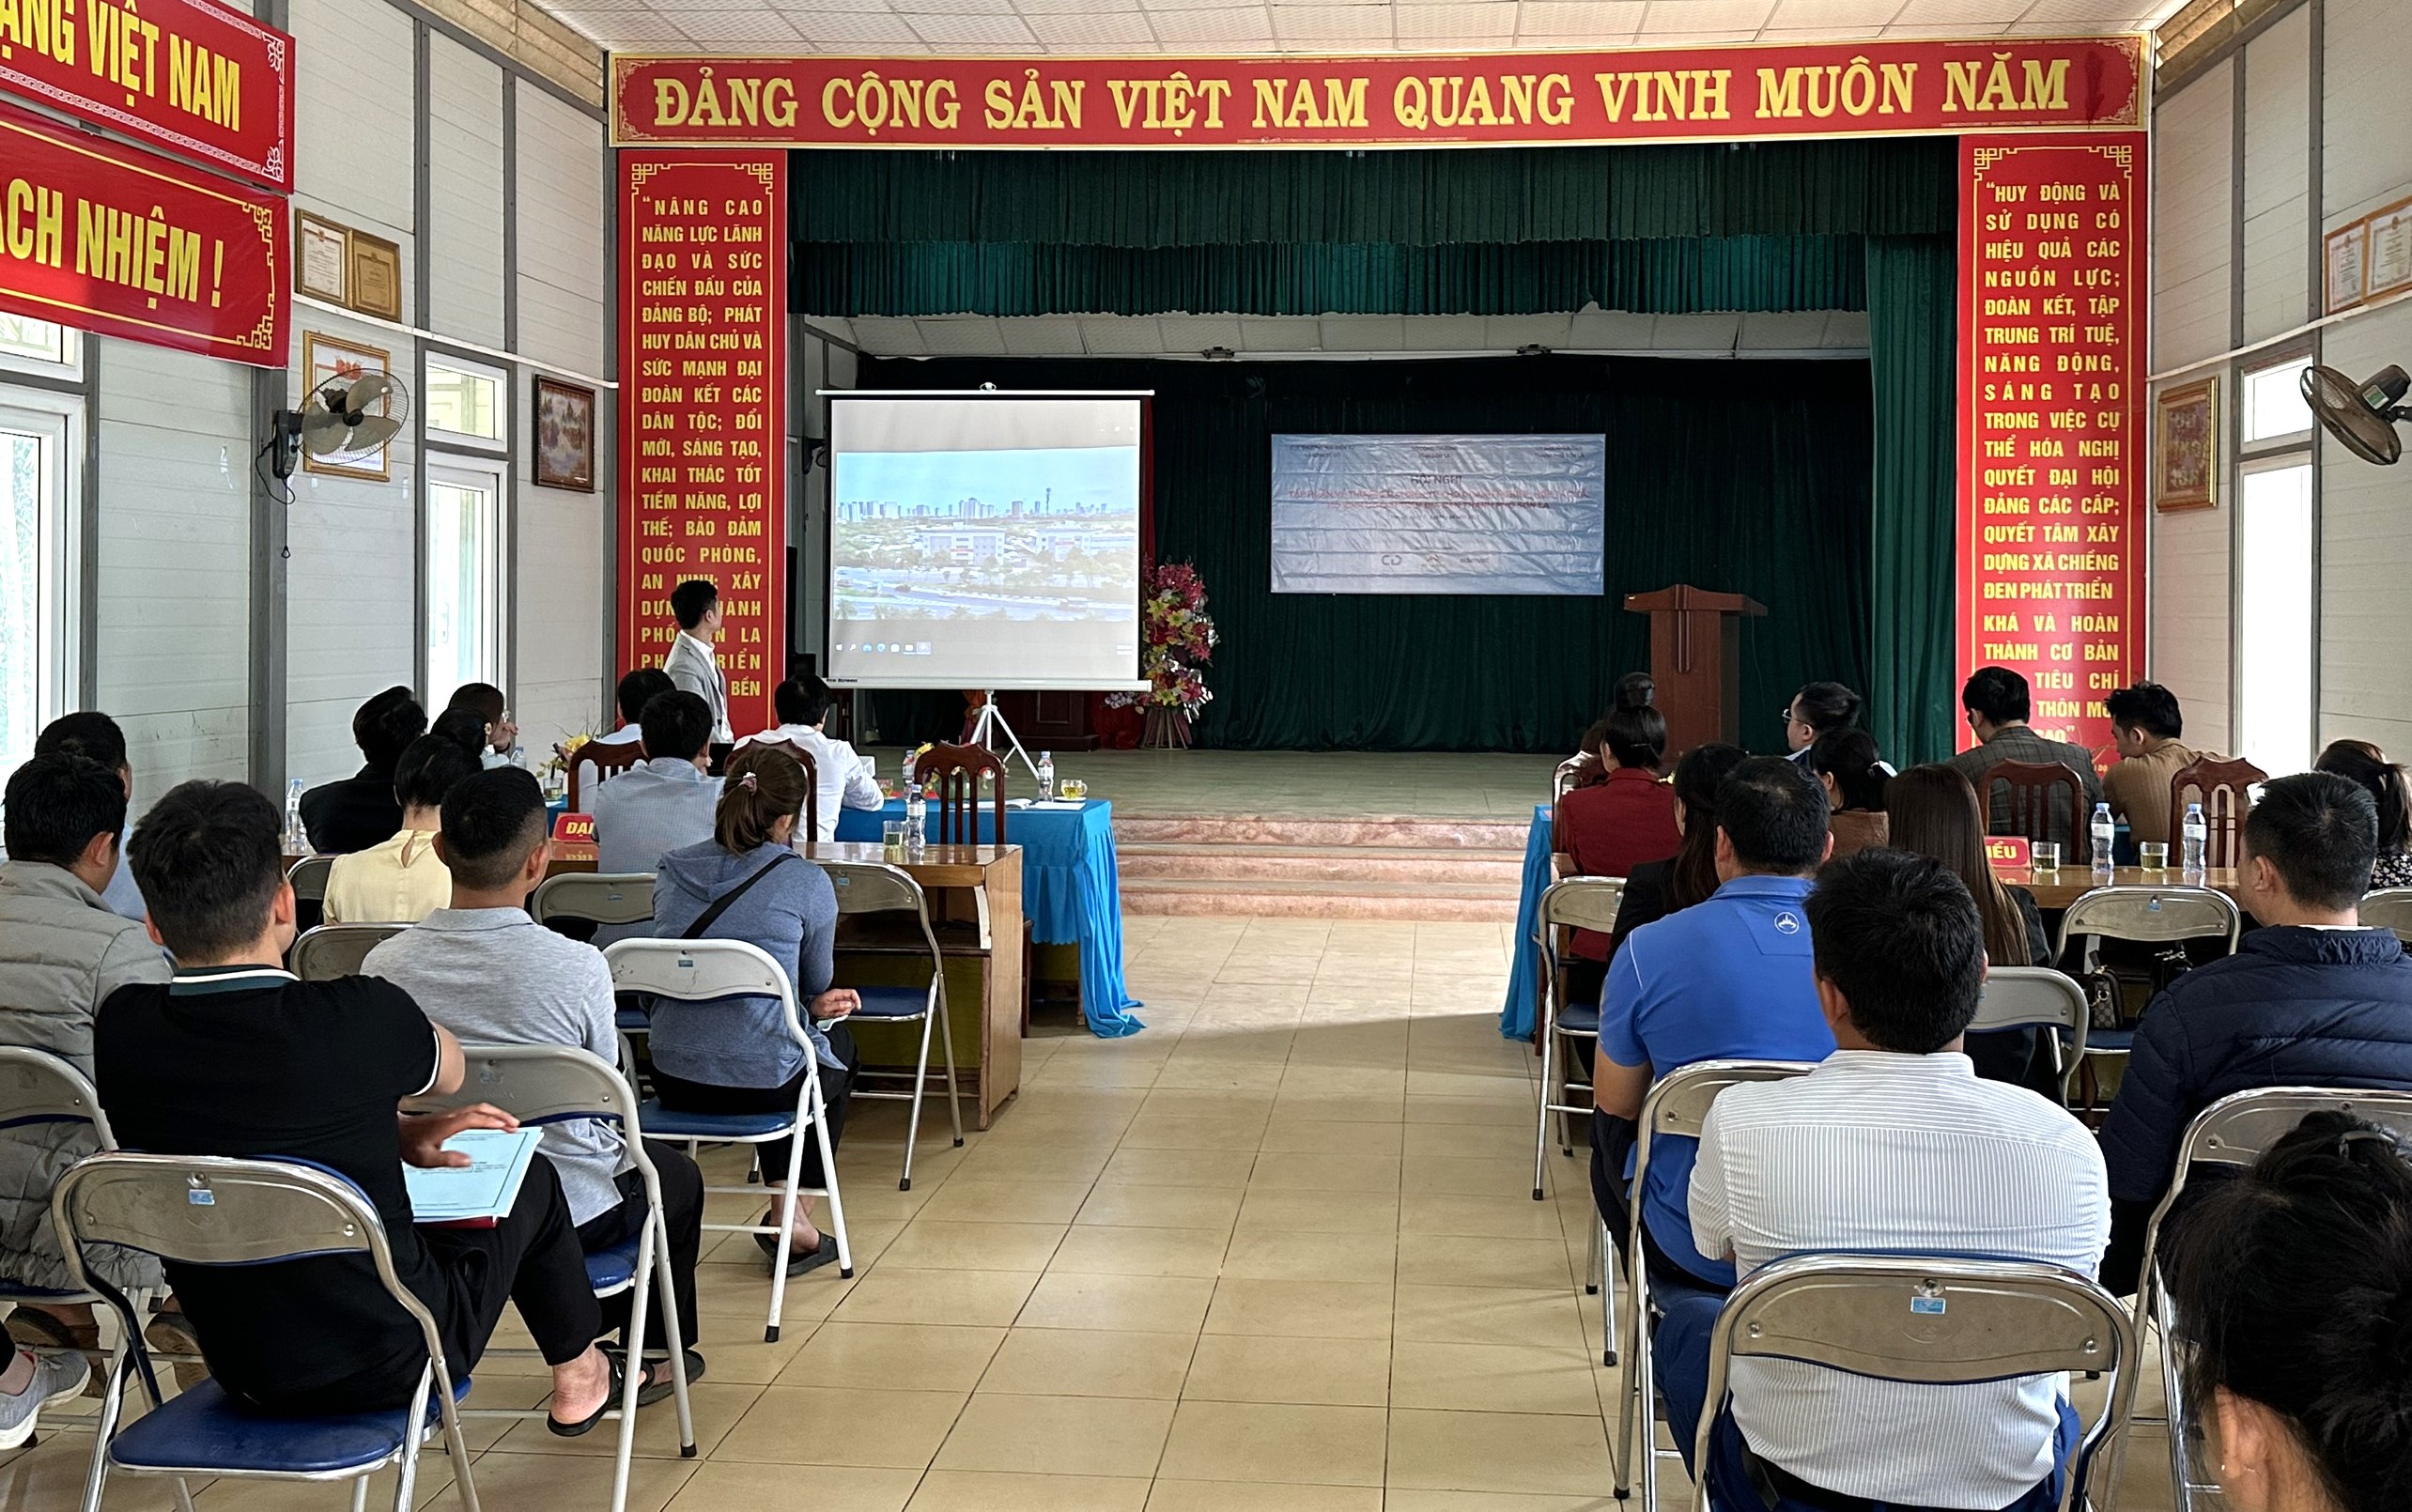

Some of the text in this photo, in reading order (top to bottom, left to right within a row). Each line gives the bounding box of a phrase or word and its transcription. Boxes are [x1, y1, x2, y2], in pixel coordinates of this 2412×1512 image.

[85, 0, 159, 107] VIỆT
[169, 33, 240, 132] NAM
[654, 51, 2070, 137] ĐẢNG CỘNG SẢN VIỆT NAM QUANG VINH MUÔN NĂM
[2040, 182, 2085, 204] ĐỘNG
[2099, 181, 2120, 200] VÀ
[726, 200, 762, 215] CAO
[1986, 209, 2119, 233] SỬ DỤNG CÓ
[0, 178, 63, 269] CH
[76, 198, 201, 310] NHIỆM
[211, 239, 224, 307] !
[642, 224, 762, 245] NĂNG LỰC LÃNH
[1986, 237, 2120, 262] HIỆU QUẢ CÁC
[642, 251, 762, 272] ĐẠO VÀ SỨC
[642, 275, 762, 296] CHIẾN ĐẤU CỦA
[1986, 265, 2119, 289] NGUỒN LỰC;
[642, 302, 762, 326] ĐẢNG BỘ; PHÁT
[1985, 294, 2119, 317] ĐOÀN KẾT, TẬP
[642, 330, 762, 349] HUY DÂN CHỦ VÀ
[1985, 323, 2119, 346] TRUNG TRÍ TUỆ,
[642, 358, 762, 379] SỨC MẠNH ĐẠI
[1985, 352, 2119, 375] NĂNG ĐỘNG,
[642, 383, 761, 403] ĐOÀN KẾT CÁC
[1985, 381, 2119, 403] SÁNG TẠO
[642, 409, 762, 432] DÂN TỘC; ĐỔI
[1985, 409, 2120, 431] TRONG VIỆC CỤ
[642, 438, 761, 459] MỚI, SÁNG TẠO,
[1985, 435, 2119, 459] THỂ HÓA NGHỊ
[642, 462, 762, 483] KHAI THÁC TỐT
[1985, 464, 2119, 488] QUYẾT ĐẠI HỘI
[642, 491, 761, 513] TIỀM NĂNG, LỢI
[1984, 492, 2119, 515] ĐẢNG CÁC CẤP;
[642, 516, 761, 537] THẾ; BẢO ĐẢM
[1985, 521, 2118, 544] QUYẾT TÂM XÂY
[642, 543, 761, 563] QUỐC PHÒNG,
[1985, 553, 2029, 574] DỰNG
[2033, 552, 2054, 570] XÃ
[642, 574, 662, 589] AN
[733, 571, 761, 589] XÂY
[1984, 577, 2112, 599] ĐEN PHÁT TRIỂN
[642, 598, 760, 619] DỰN ÀNH
[642, 622, 675, 643] PHỐ
[741, 627, 760, 642] LA
[1984, 612, 2118, 632] KHÁ VÀ HOÀN
[642, 648, 760, 670] PH RIỂN
[1984, 640, 2118, 660] THÀNH CƠ BẢN
[2035, 670, 2118, 689] TIÊU CHÍ
[2037, 699, 2080, 717] THÔN
[1986, 841, 2018, 859] IỂU
